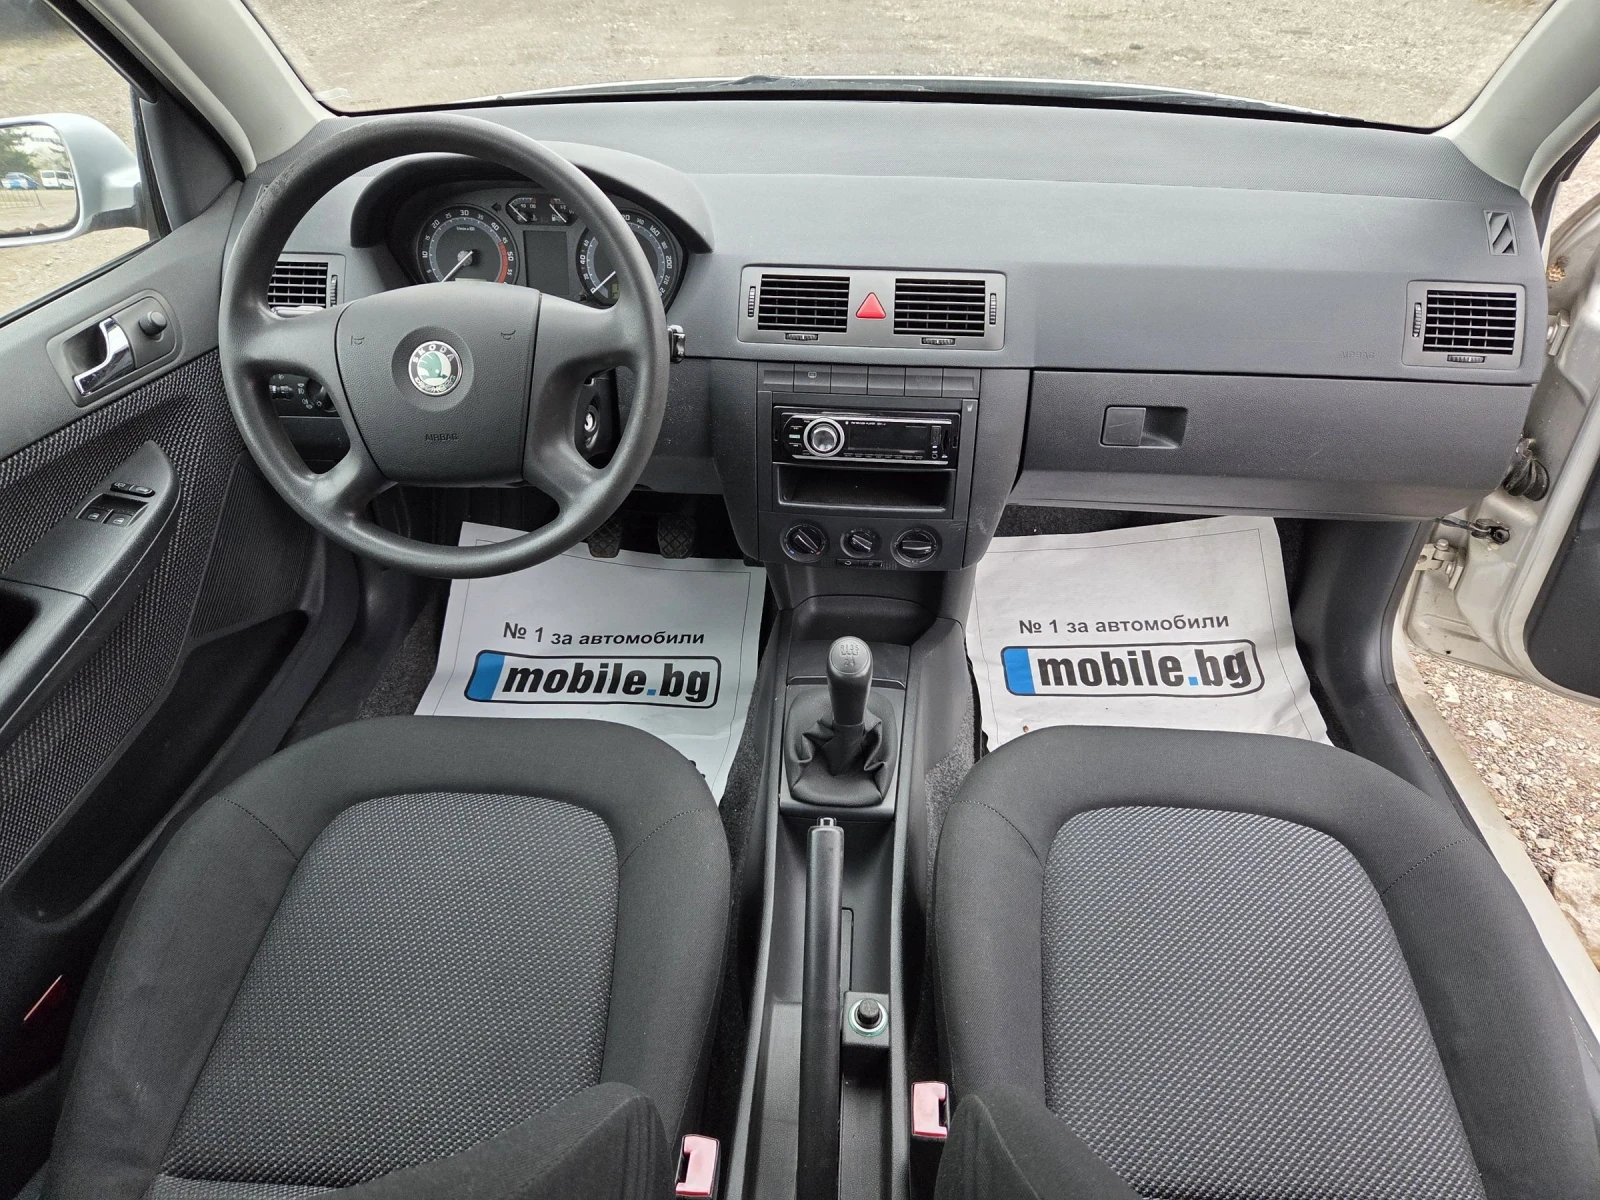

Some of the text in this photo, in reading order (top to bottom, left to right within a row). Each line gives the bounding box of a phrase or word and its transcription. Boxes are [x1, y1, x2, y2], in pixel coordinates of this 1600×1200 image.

[430, 219, 440, 229] 20
[490, 222, 500, 231] 40
[649, 225, 660, 237] 160
[507, 251, 514, 261] 50
[579, 255, 586, 265] 40
[425, 433, 458, 441] AIRBAG
[1019, 614, 1229, 634] № 1 за автомобили
[503, 621, 705, 645] № 1 за автомобили
[1037, 648, 1252, 689] mobile.bg
[502, 662, 710, 703] mobile.bg
